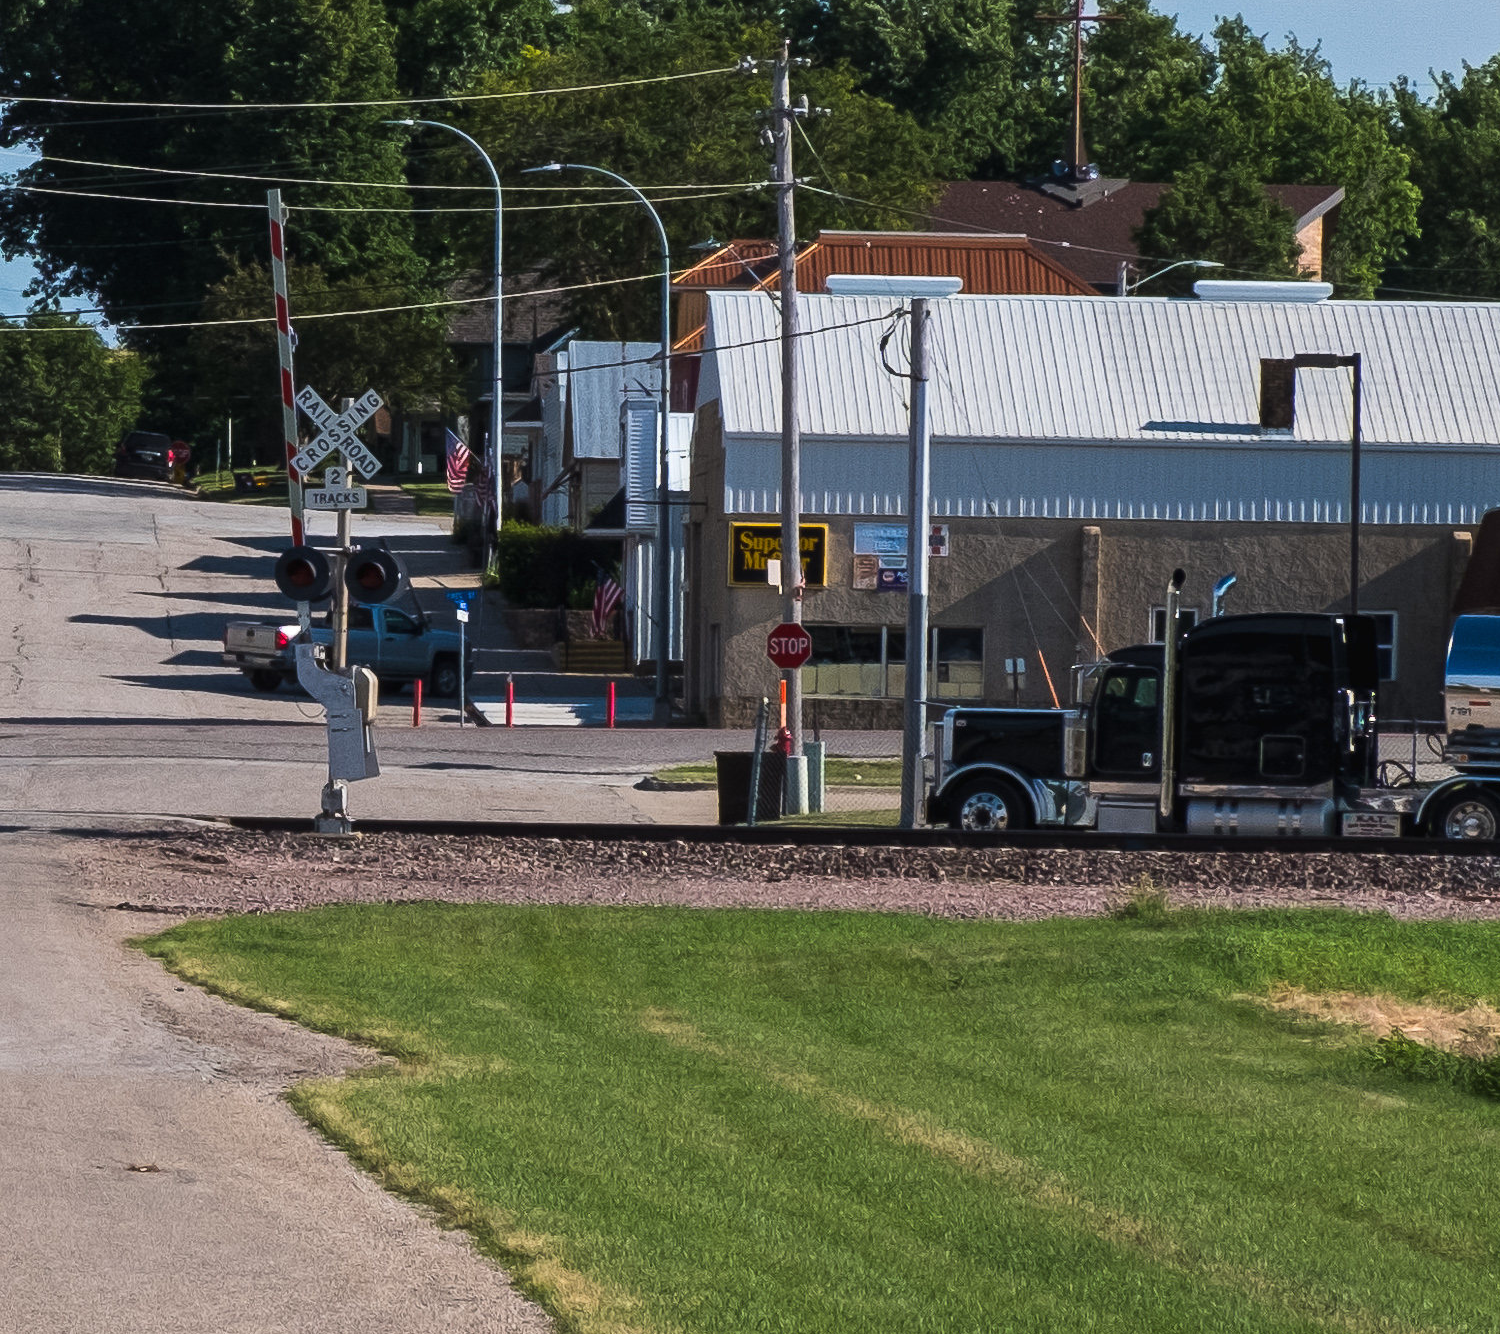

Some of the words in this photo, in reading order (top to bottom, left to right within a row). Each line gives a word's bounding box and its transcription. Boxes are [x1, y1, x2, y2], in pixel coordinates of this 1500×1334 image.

[295, 393, 380, 471] CROSSING
[330, 468, 341, 485] 2
[312, 492, 360, 504] TRACKS
[740, 530, 818, 554] Supeor
[769, 637, 808, 655] STOP
